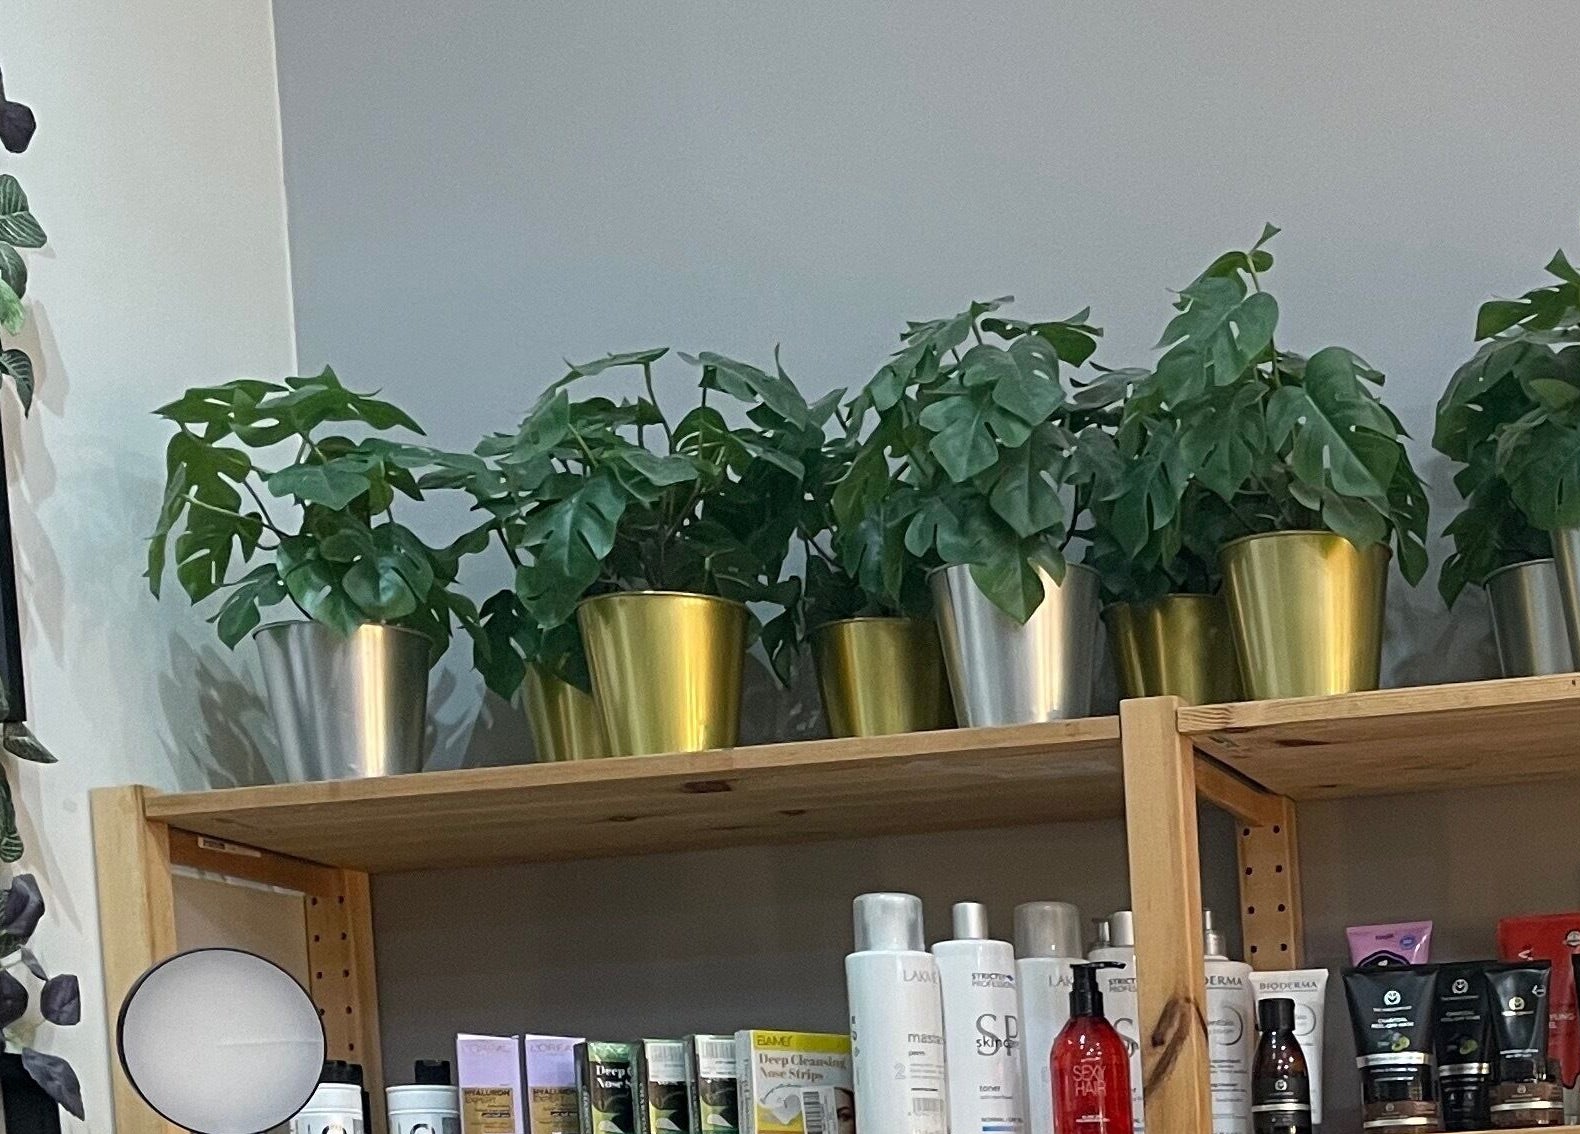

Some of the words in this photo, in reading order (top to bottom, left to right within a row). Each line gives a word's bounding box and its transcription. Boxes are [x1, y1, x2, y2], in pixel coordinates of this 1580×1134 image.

[1260, 981, 1318, 991] BIODERMA
[759, 1053, 789, 1067] Deep
[790, 1054, 848, 1070] Cleansing
[789, 1069, 824, 1082] Strips
[1072, 1065, 1107, 1082] SEXY
[1075, 1081, 1107, 1097] HAIR
